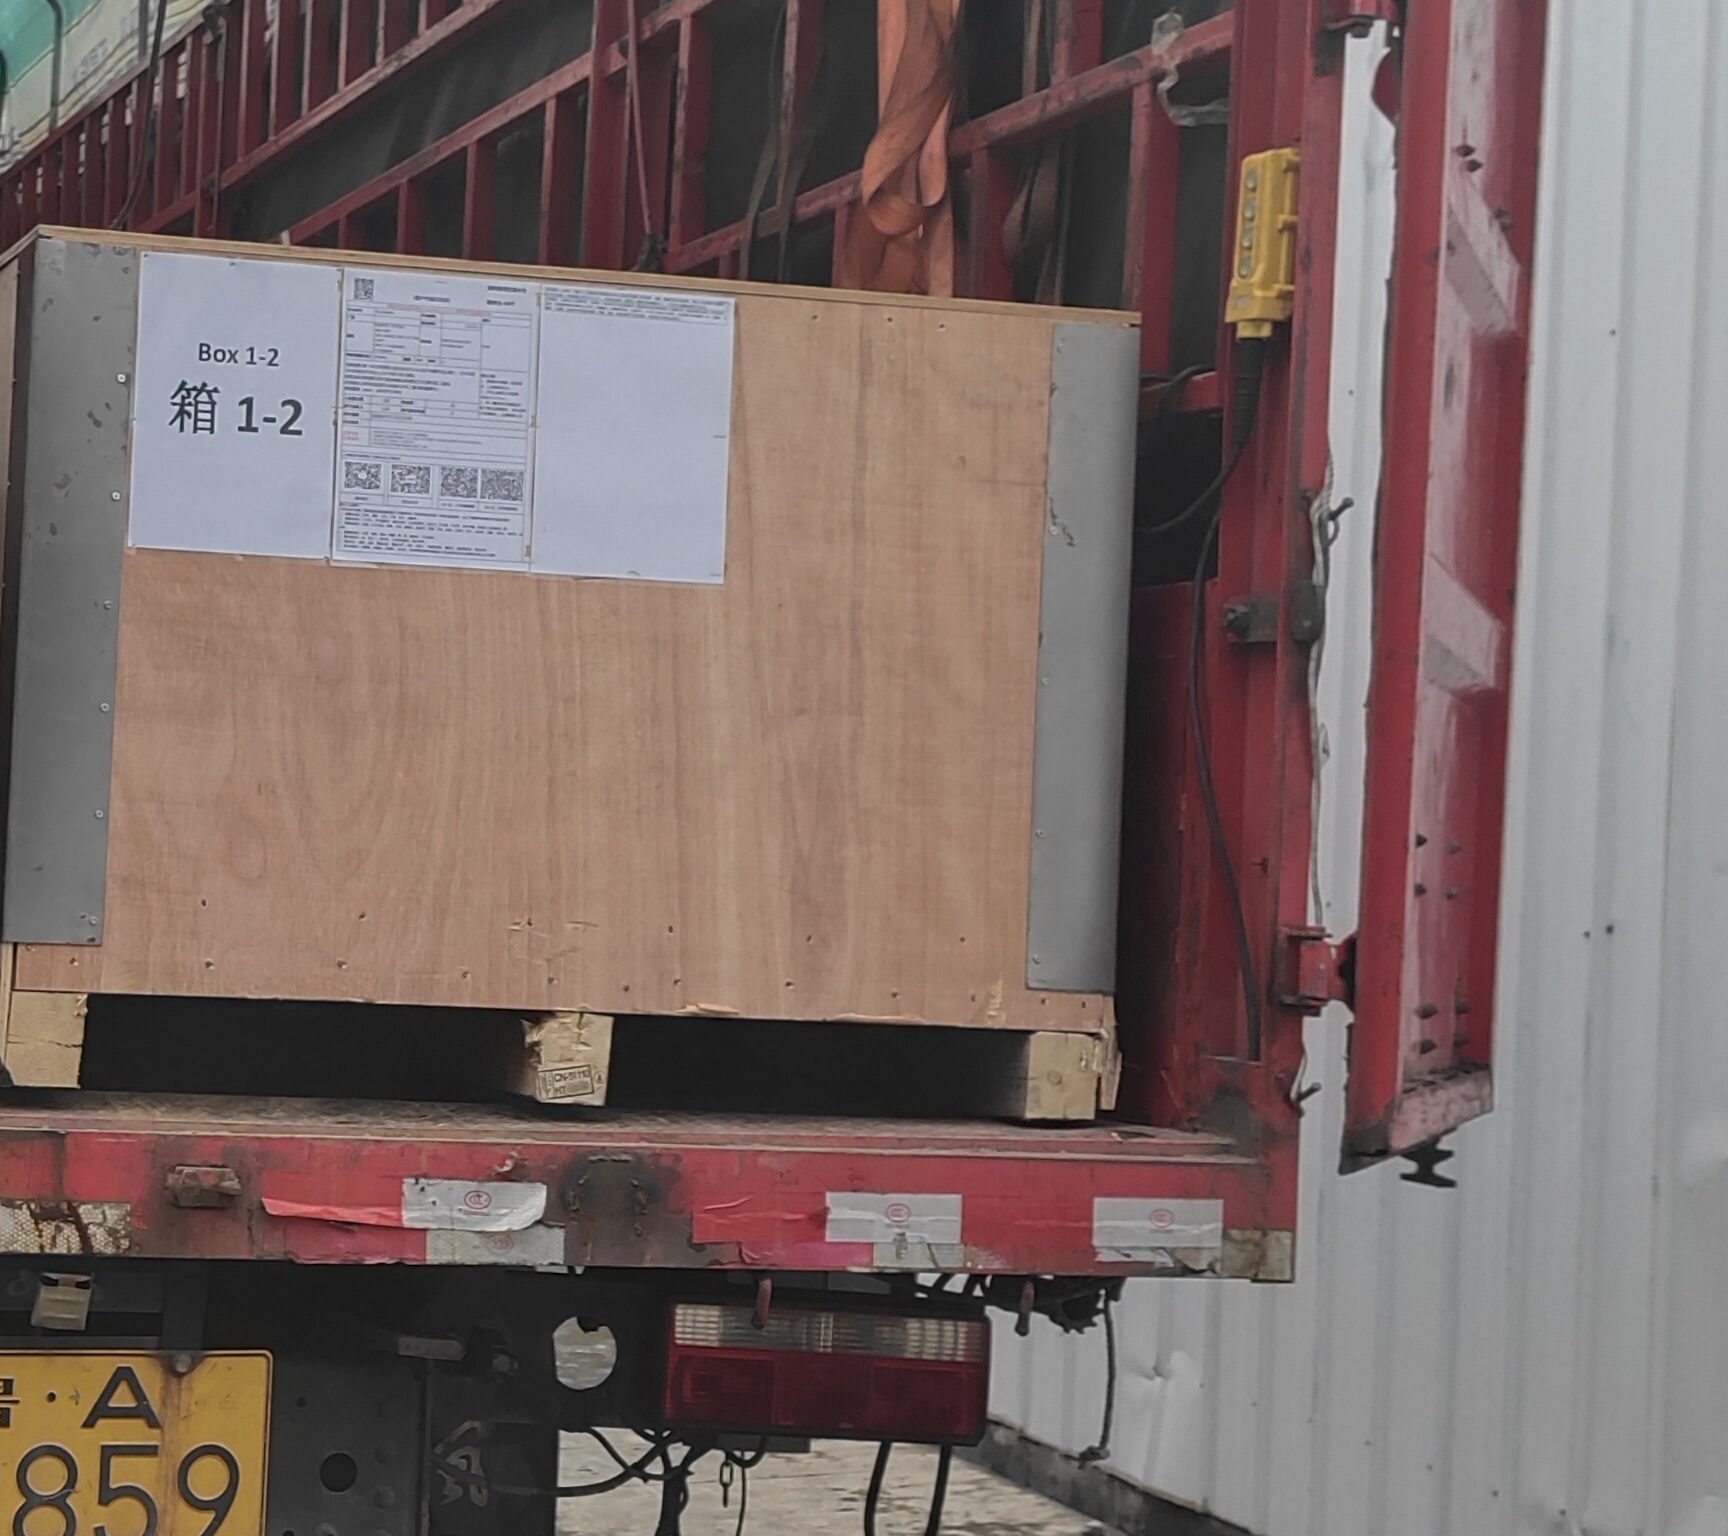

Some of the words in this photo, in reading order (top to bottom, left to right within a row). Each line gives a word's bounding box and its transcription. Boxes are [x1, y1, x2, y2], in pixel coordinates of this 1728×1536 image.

[198, 342, 239, 364] Box
[245, 346, 280, 367] 1-2
[168, 379, 221, 435] 箱
[237, 396, 303, 436] 1-2
